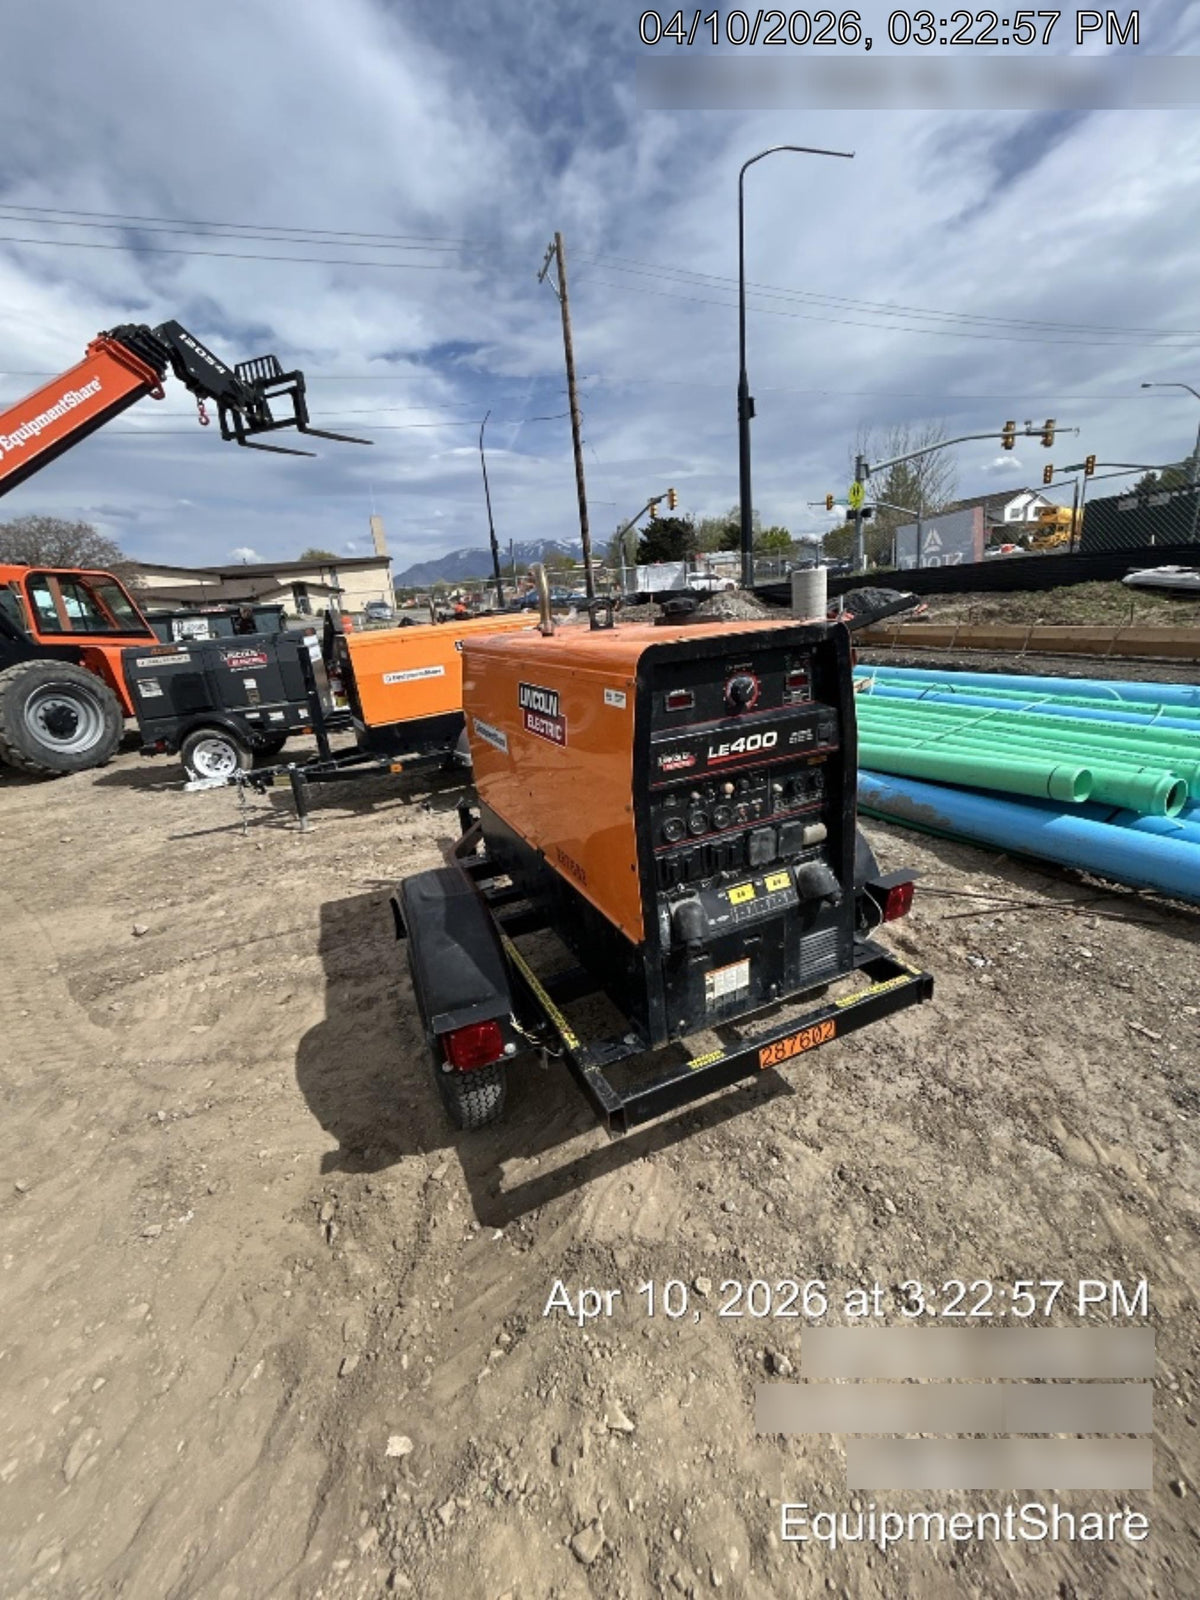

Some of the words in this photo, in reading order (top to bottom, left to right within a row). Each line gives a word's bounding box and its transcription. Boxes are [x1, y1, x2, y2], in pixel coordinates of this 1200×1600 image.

[0, 376, 102, 451] EquipmentShare
[520, 684, 558, 716] LINCOLN
[527, 715, 564, 741] ELECTRIC
[708, 731, 778, 759] LE400
[761, 1020, 836, 1068] 287602
